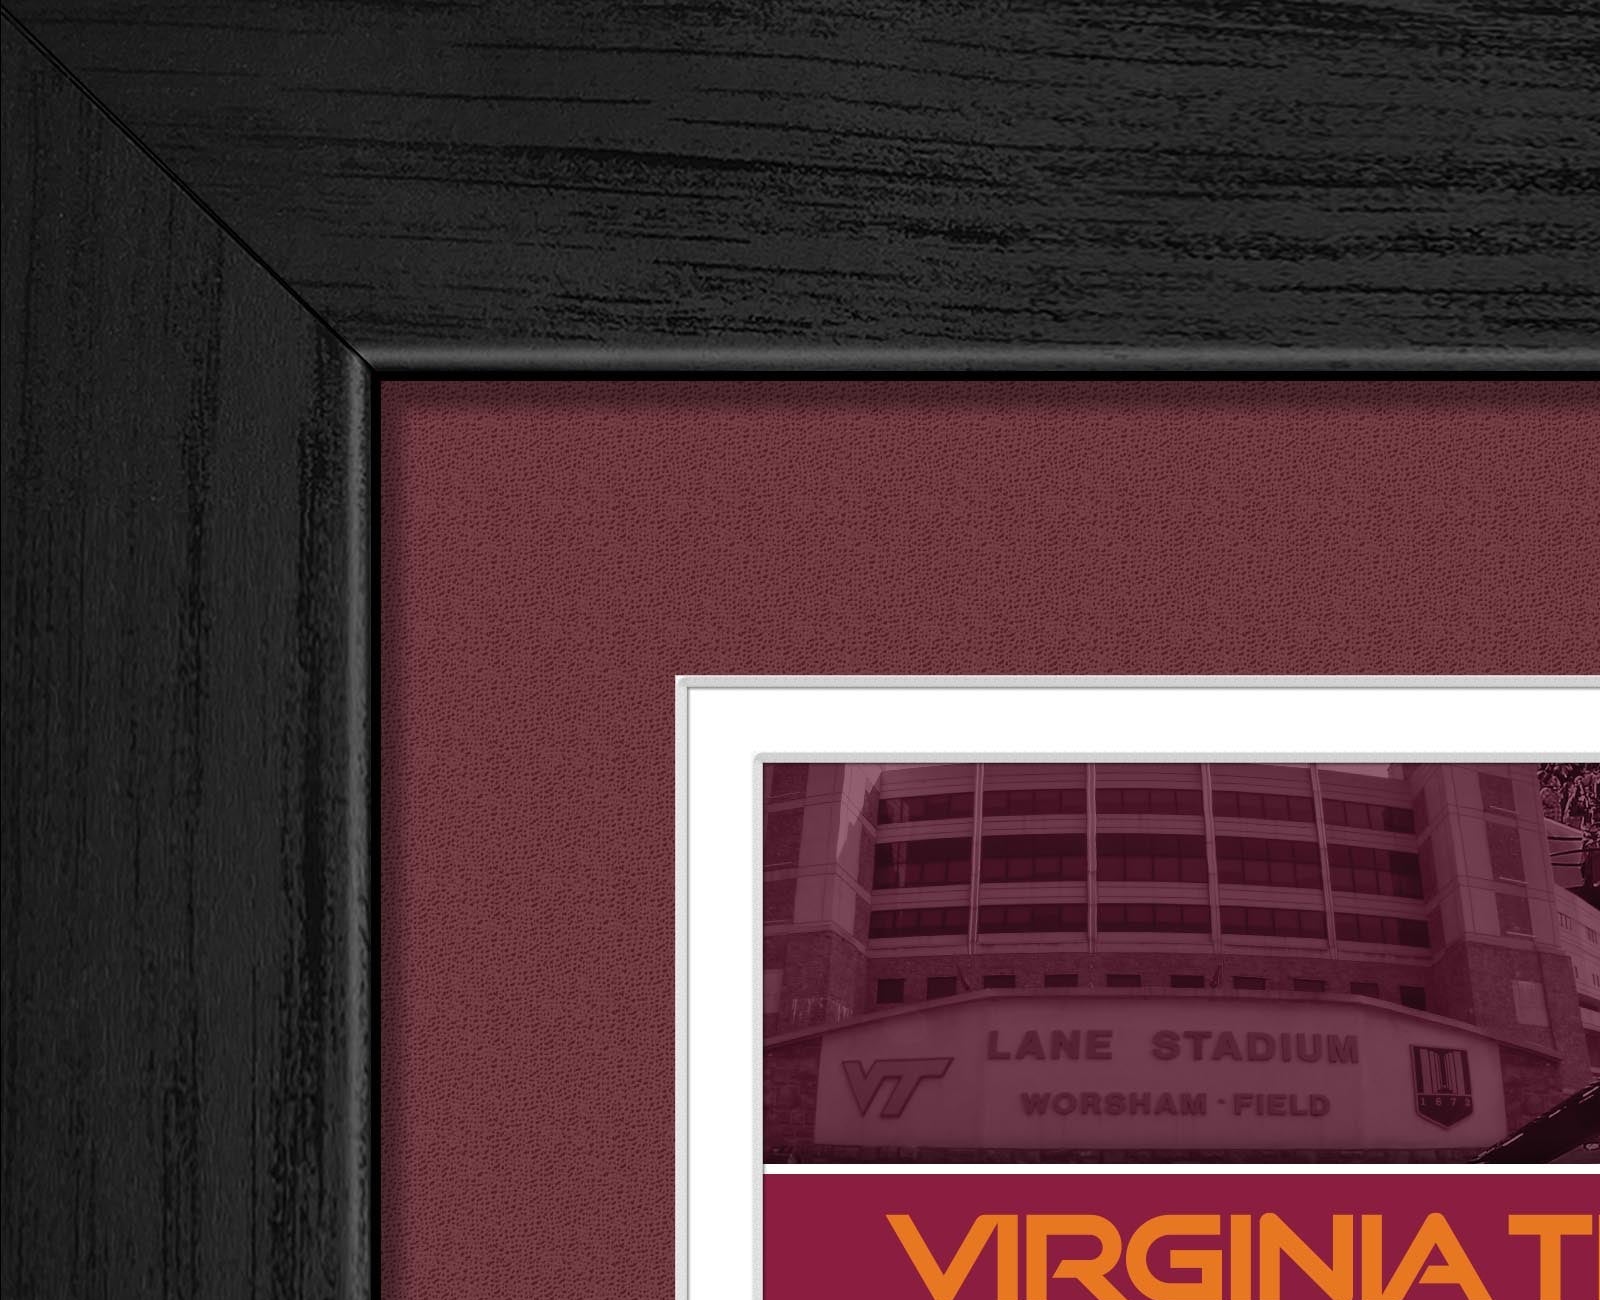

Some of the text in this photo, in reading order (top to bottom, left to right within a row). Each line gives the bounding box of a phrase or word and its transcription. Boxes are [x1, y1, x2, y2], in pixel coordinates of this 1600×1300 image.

[986, 1029, 1360, 1065] LANE STADIUM
[842, 1057, 954, 1119] VT
[1021, 1092, 1330, 1117] WORSHAM FIELD
